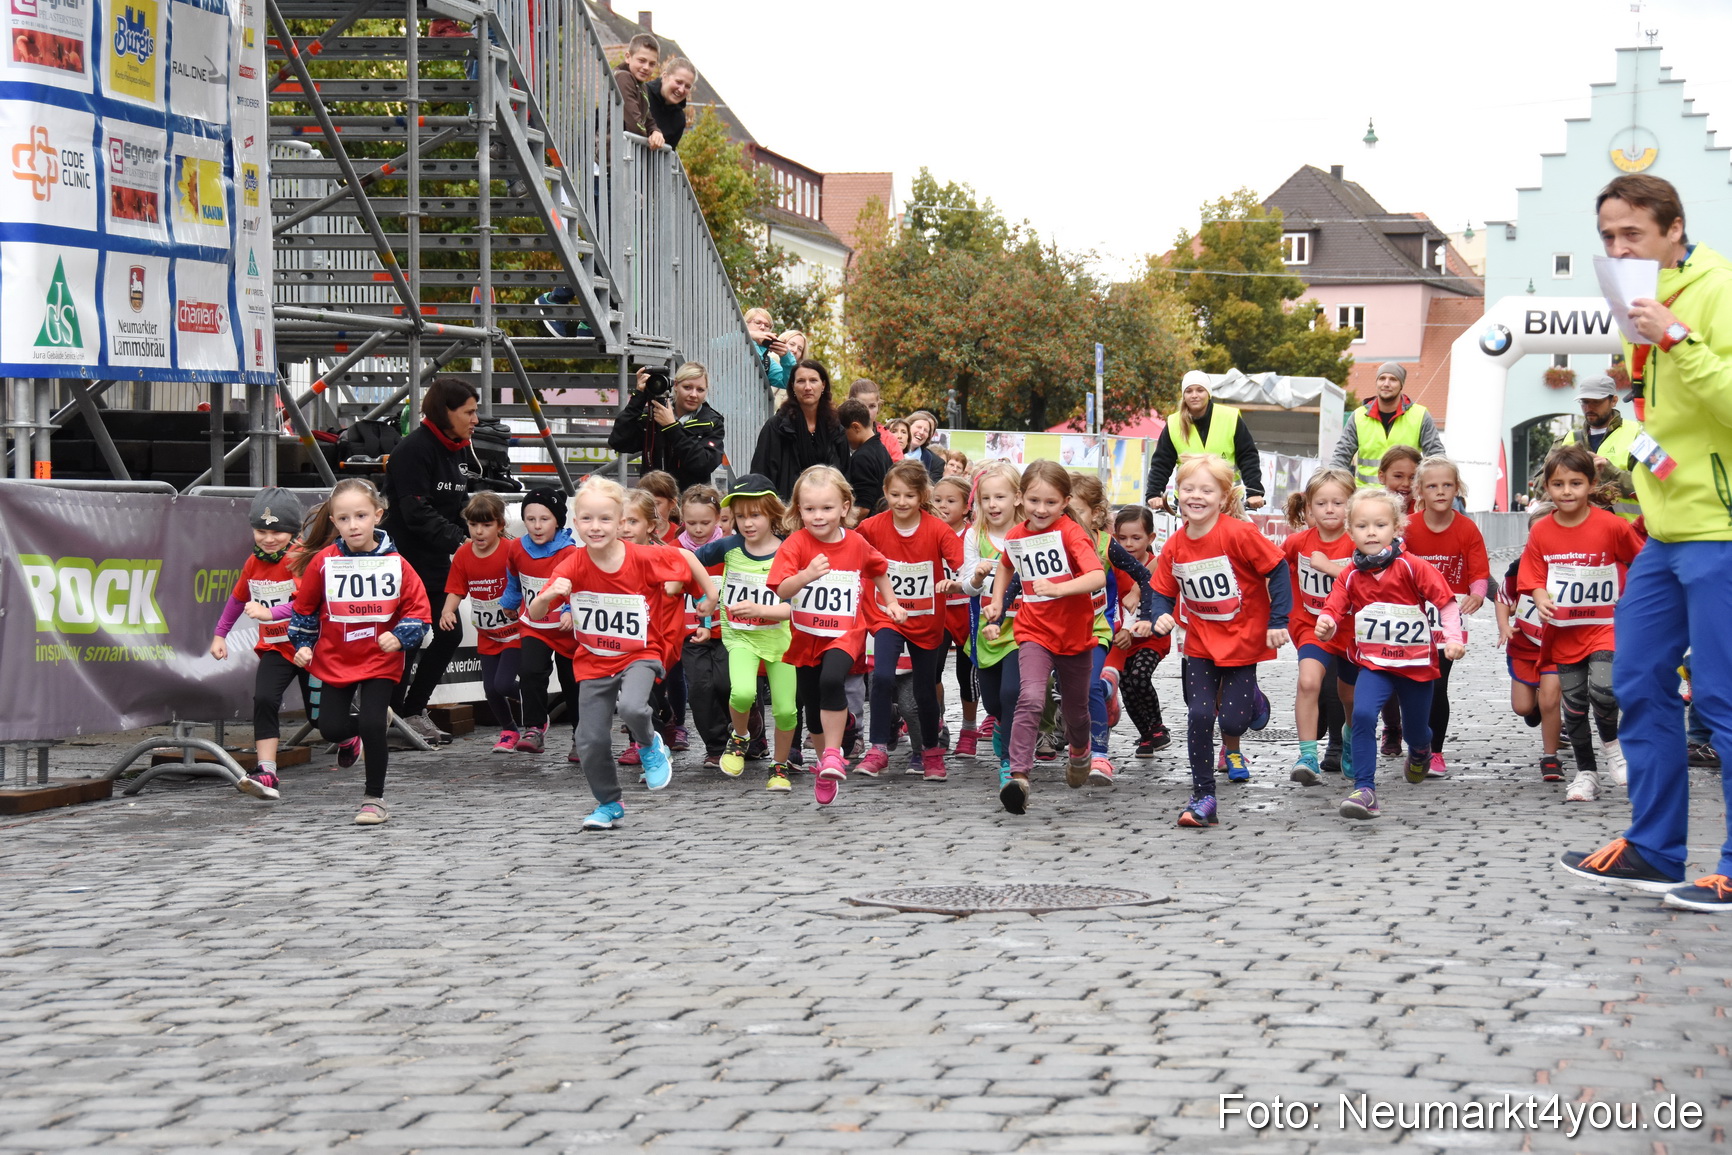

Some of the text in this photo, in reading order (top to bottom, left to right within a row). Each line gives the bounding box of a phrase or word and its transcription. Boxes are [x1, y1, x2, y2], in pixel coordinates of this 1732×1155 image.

[62, 149, 85, 169] CODE
[63, 169, 91, 189] CLINIC
[202, 205, 223, 220] KANN
[118, 319, 158, 335] Neumarkter
[1525, 310, 1613, 334] BMW
[33, 351, 46, 359] Jura
[113, 336, 165, 357] Lammsbräu
[437, 481, 452, 491] get
[334, 573, 396, 598] 7013
[888, 573, 928, 597] 237
[1176, 573, 1230, 599] 7109
[1301, 569, 1335, 595] 710
[801, 585, 851, 612] 7031
[1556, 580, 1613, 604] 7040
[349, 604, 382, 615] Sophia
[1195, 603, 1219, 613] Laura
[1569, 609, 1596, 618] Marie
[474, 609, 518, 628] 724
[579, 607, 640, 636] 7045
[813, 617, 839, 628] Paula
[1364, 617, 1425, 643] 7122
[84, 643, 130, 662] smart
[597, 638, 621, 650] Frida
[1381, 646, 1405, 658] Anna
